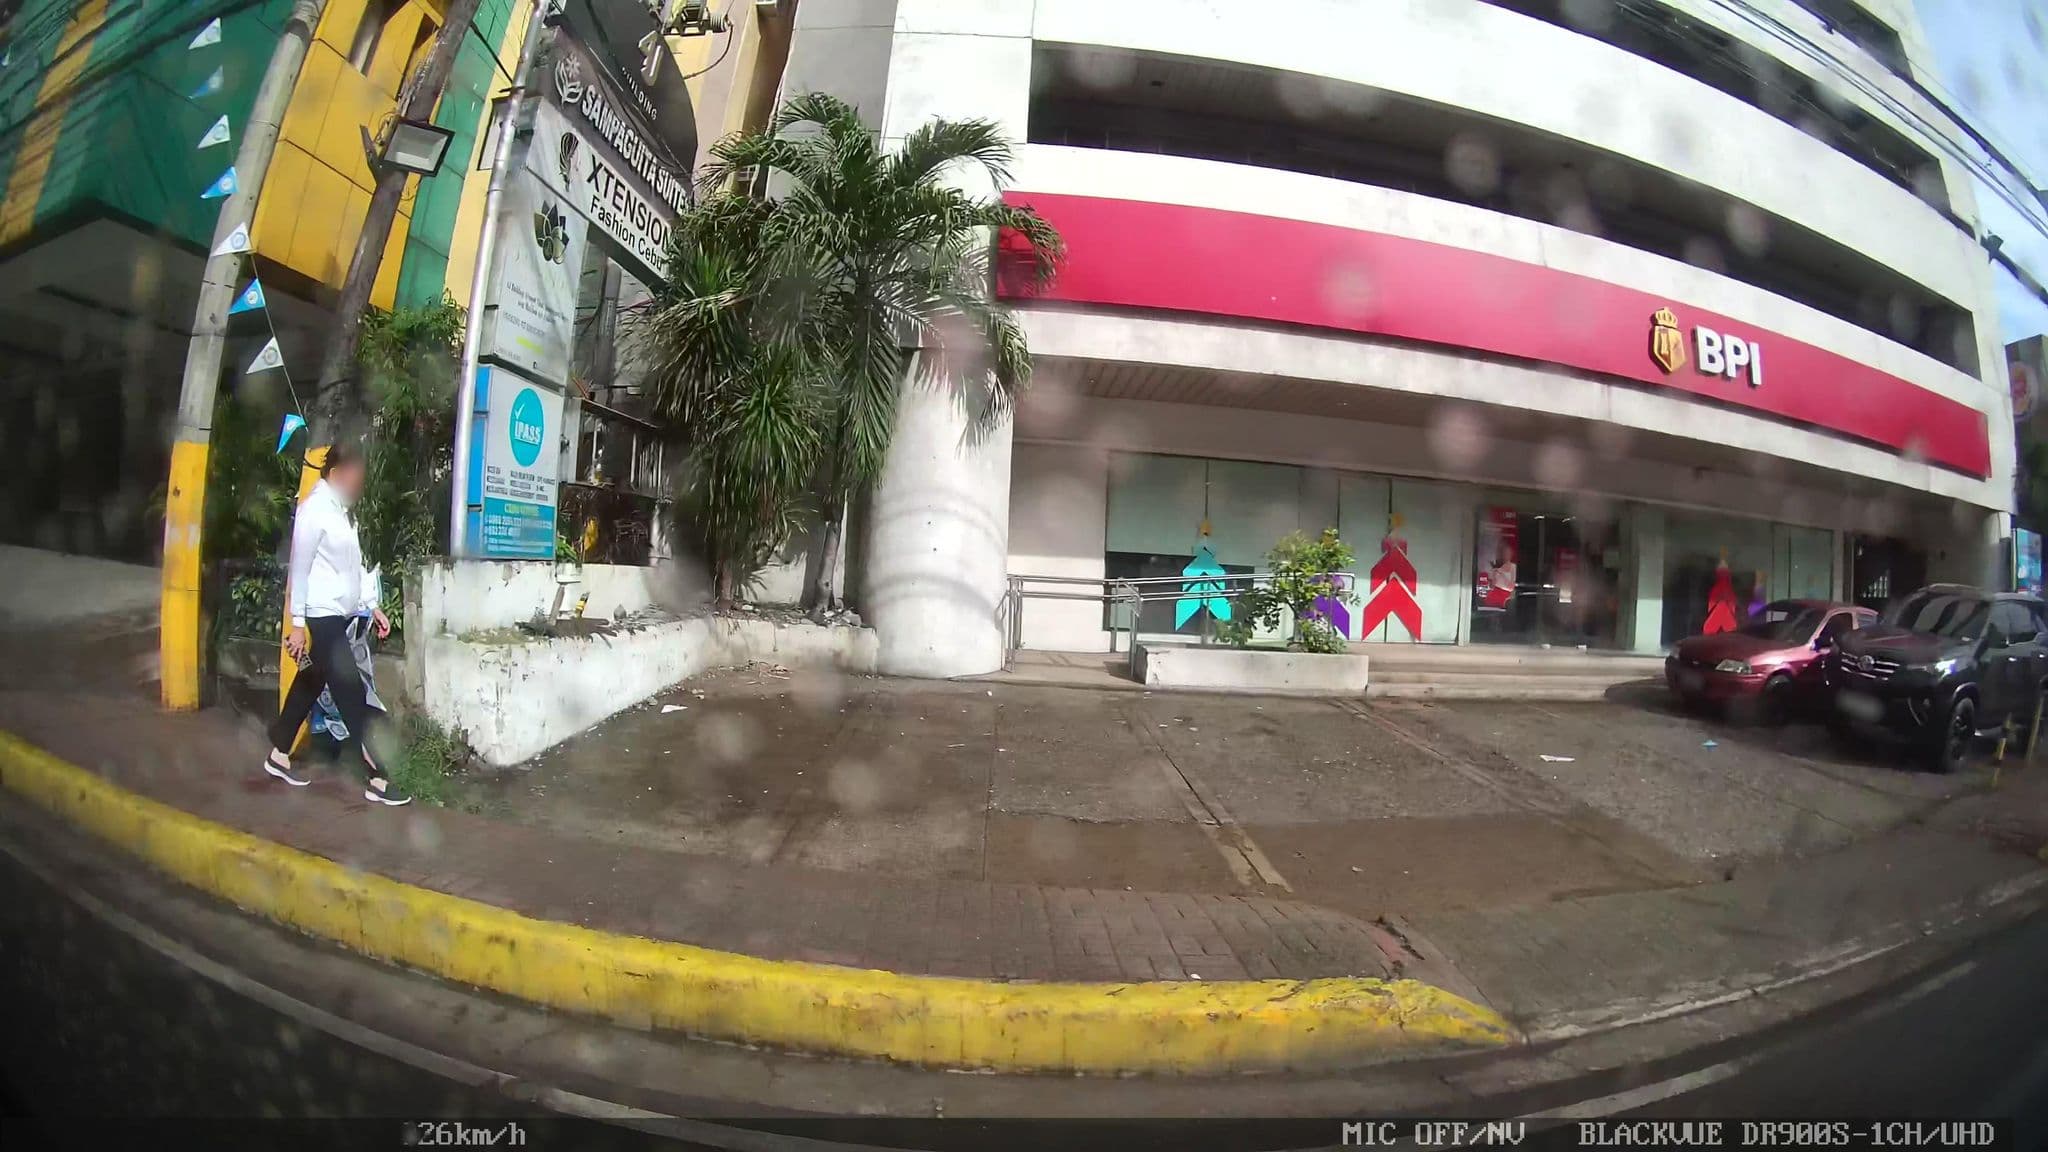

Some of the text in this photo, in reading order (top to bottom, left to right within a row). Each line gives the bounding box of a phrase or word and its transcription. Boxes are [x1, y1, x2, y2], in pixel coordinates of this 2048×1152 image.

[582, 84, 657, 189] SAMPAGUITA
[587, 154, 671, 252] XTENSION
[590, 195, 662, 270] Fashion Cebu
[1696, 324, 1762, 385] BPI
